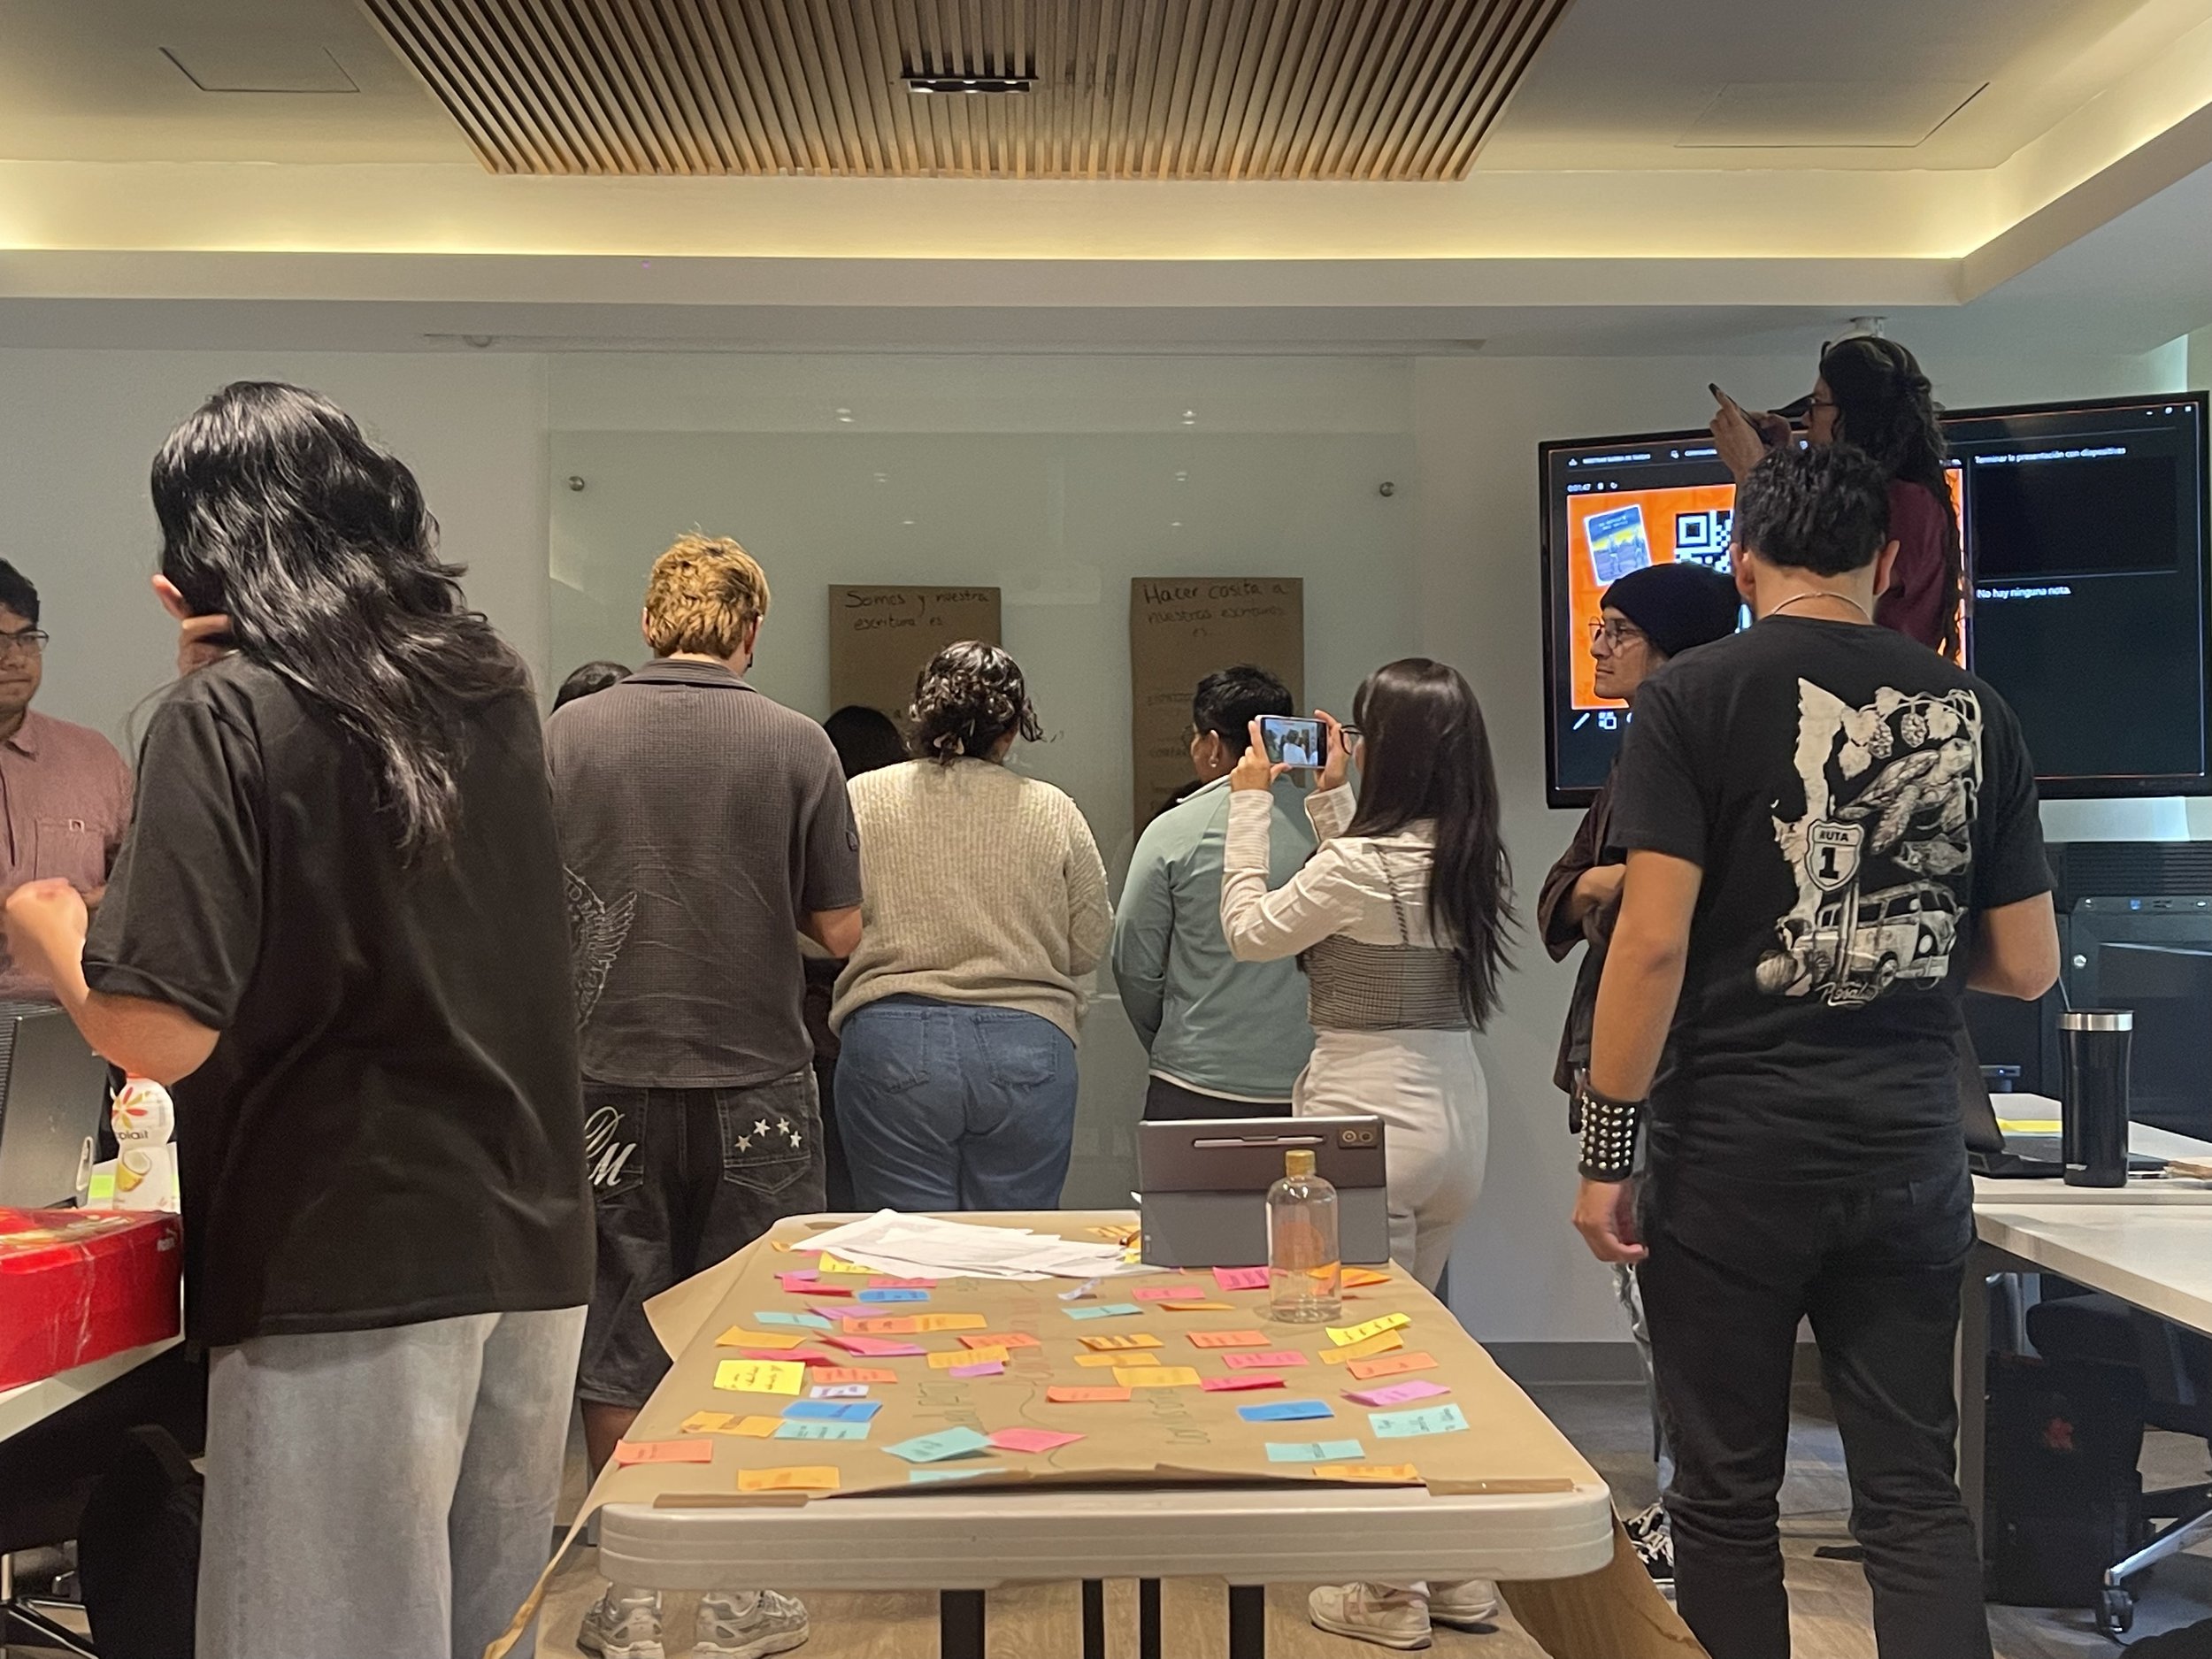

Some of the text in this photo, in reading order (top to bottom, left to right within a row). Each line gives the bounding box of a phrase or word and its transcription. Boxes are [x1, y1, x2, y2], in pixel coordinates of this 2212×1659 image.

[1143, 583, 1198, 604] Hacer
[1272, 584, 1287, 595] a
[1976, 589, 1992, 598] No
[1992, 588, 2009, 599] hay
[2009, 587, 2047, 599] ninguna
[845, 590, 989, 618] Somos y nuestra
[1819, 831, 1849, 841] RUTA
[1819, 847, 1839, 879] 1
